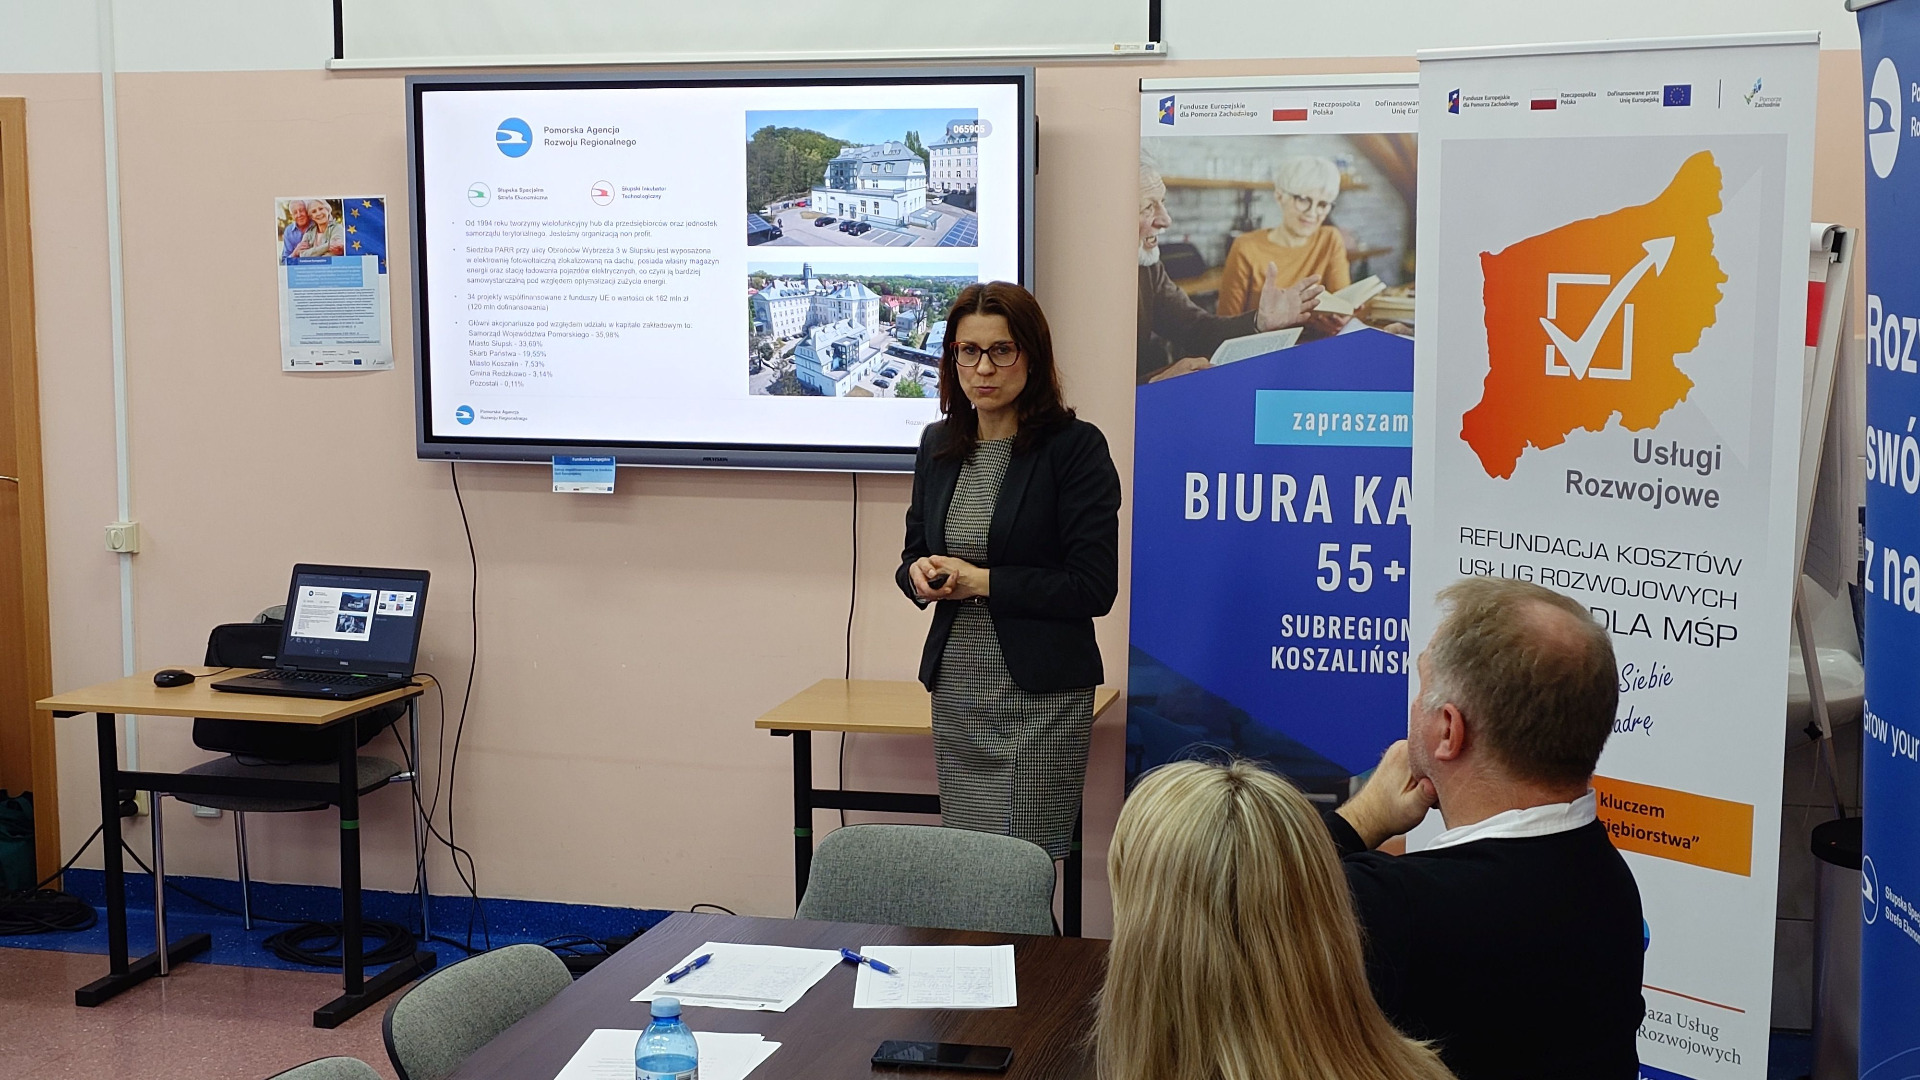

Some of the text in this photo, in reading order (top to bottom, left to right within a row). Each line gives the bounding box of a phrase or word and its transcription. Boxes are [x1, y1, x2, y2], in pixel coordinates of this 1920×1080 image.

[1210, 102, 1246, 111] Europejskie
[1313, 100, 1360, 109] Rzeczpospolita
[1484, 94, 1510, 102] Europejskie
[1219, 110, 1258, 119] Zachodniego
[543, 126, 620, 136] Pomorska Agencja
[544, 138, 637, 148] Rozwoju Regionalnego
[1868, 294, 1920, 374] Roz
[1292, 411, 1413, 437] zapraszam
[1633, 438, 1722, 475] Usługi
[1866, 416, 1920, 494] swó
[1184, 472, 1412, 526] BIURA KA
[1566, 469, 1720, 510] Rozwojowe
[1316, 542, 1406, 592] 55+
[1460, 526, 1742, 576] REFUNDACJA KOSZTÓW
[1460, 557, 1738, 610] USŁUG ROZWOJOWYCH
[1865, 538, 1920, 614] z na
[1281, 614, 1410, 642] SUBREGION
[1664, 616, 1738, 648] MŚP
[1618, 662, 1674, 694] Siebie
[1864, 698, 1920, 762] Grow your
[1600, 792, 1666, 819] kluczem
[1884, 886, 1908, 912] Słupska
[1885, 906, 1903, 929] Strefa
[1646, 1008, 1720, 1042] aza Usług
[1638, 1024, 1742, 1065] Rozwojowych
